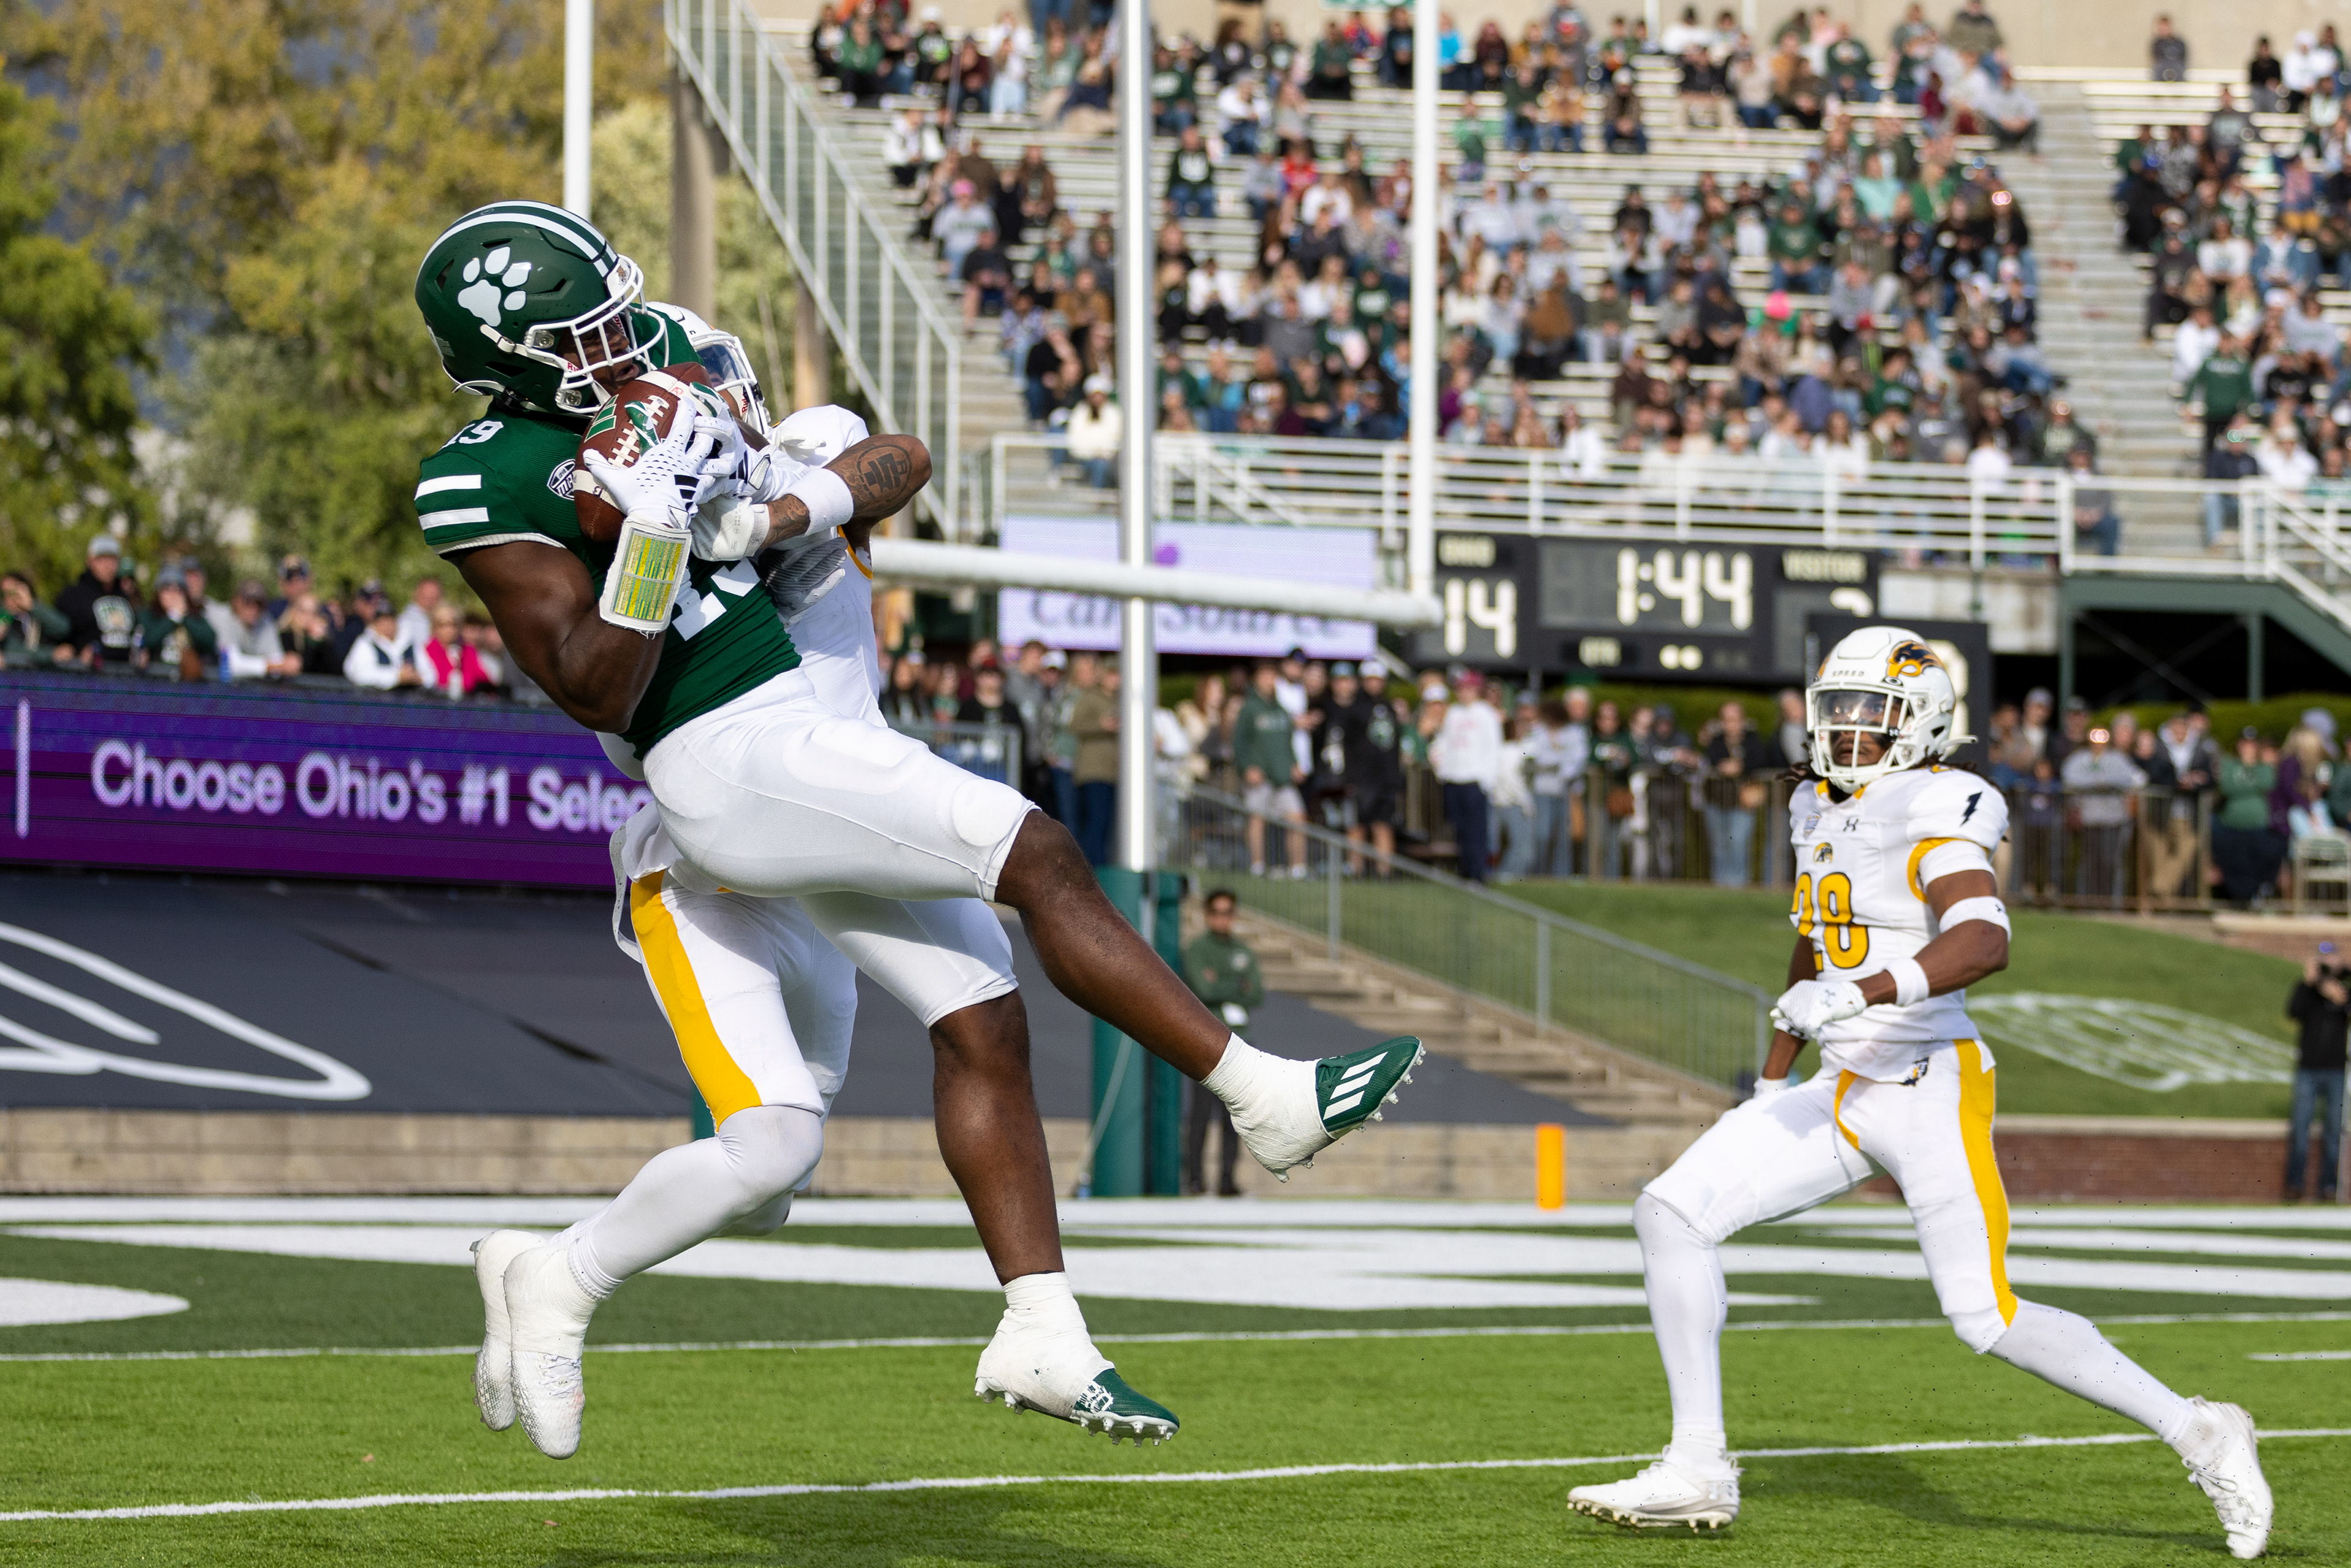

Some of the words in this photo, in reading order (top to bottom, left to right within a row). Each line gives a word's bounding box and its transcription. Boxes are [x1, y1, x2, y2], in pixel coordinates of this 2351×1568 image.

[1444, 578, 1517, 658] 14
[1617, 547, 1753, 629] 1:44
[92, 741, 284, 813] Choose
[296, 752, 446, 822] Ohio's
[459, 765, 509, 824] #1
